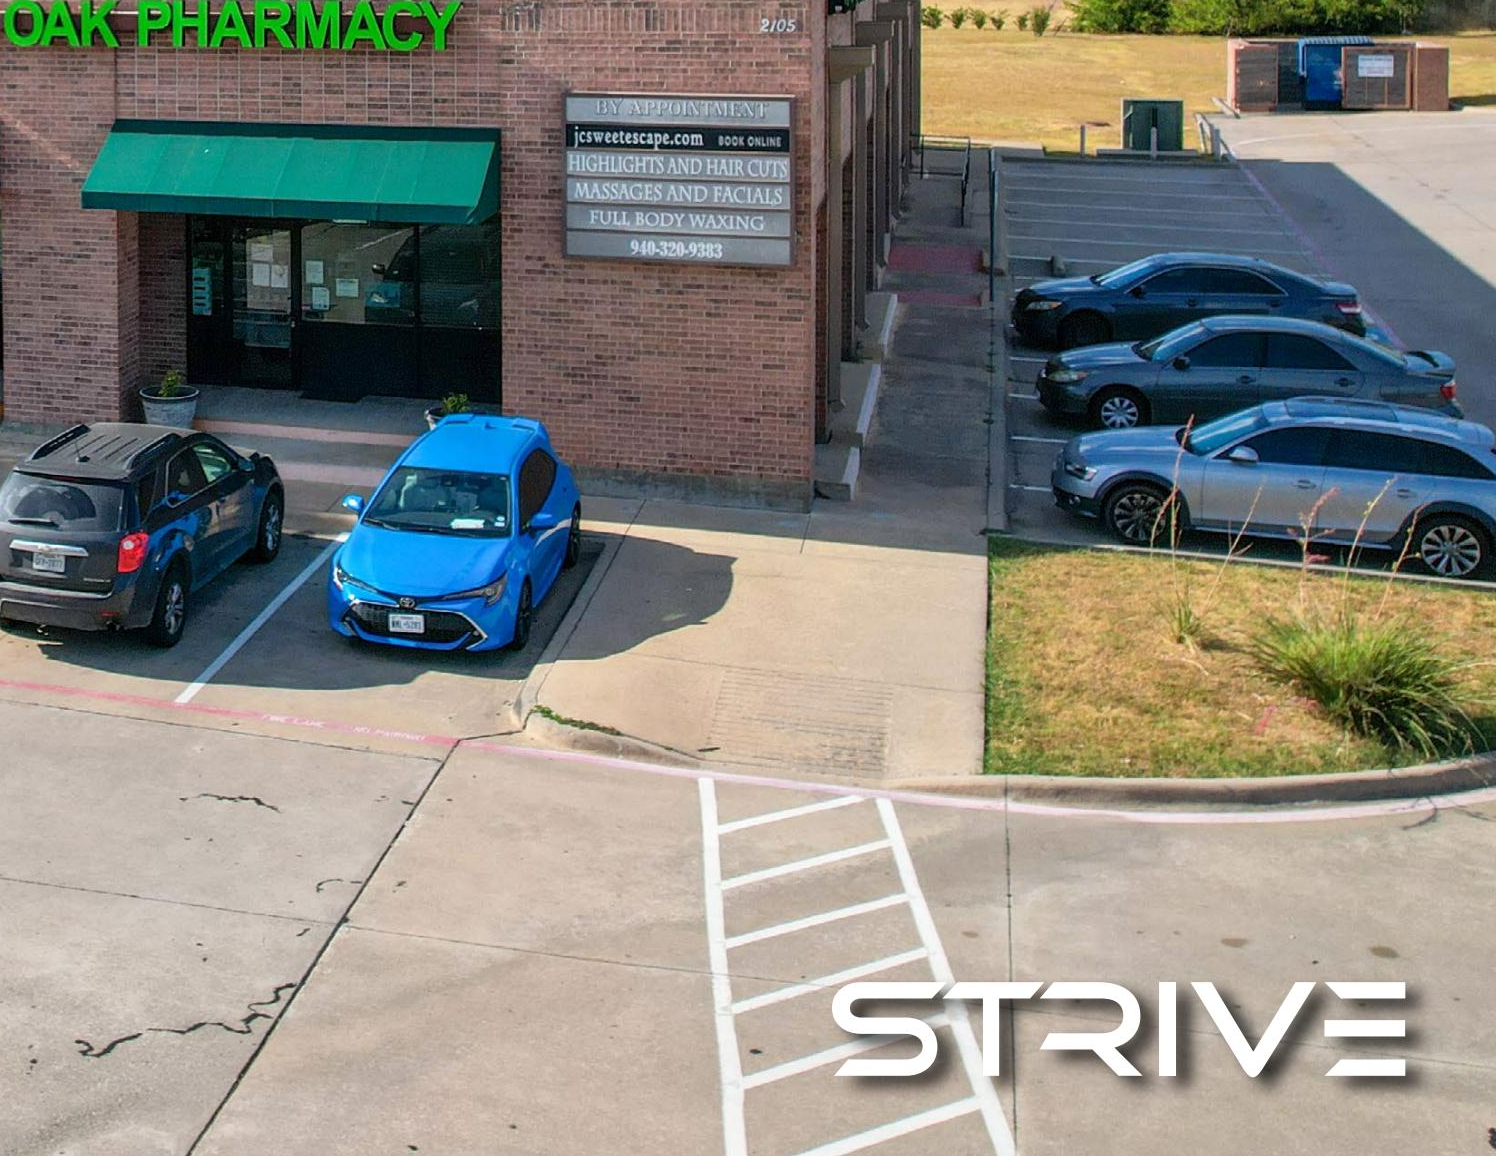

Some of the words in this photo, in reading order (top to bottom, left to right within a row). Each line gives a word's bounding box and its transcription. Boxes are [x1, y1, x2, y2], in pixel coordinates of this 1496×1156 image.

[138, 0, 463, 51] PHARMACY
[760, 18, 797, 33] 2105
[596, 99, 624, 116] BY
[630, 99, 770, 119] APPOINTMENT
[574, 126, 705, 150] jcsweetescape.com
[718, 136, 745, 147] BOOK
[747, 136, 783, 148] ONLINE
[568, 154, 664, 174] HIGHLIGHTS
[667, 156, 703, 176] AND
[706, 158, 744, 177] HAIR
[747, 159, 789, 180] CUTS
[574, 182, 663, 201] MASSAGES
[667, 184, 708, 203] AND
[713, 186, 783, 205] FACIALS
[589, 210, 630, 226] FULL
[635, 211, 686, 229] BODY
[689, 213, 765, 231] WAXING
